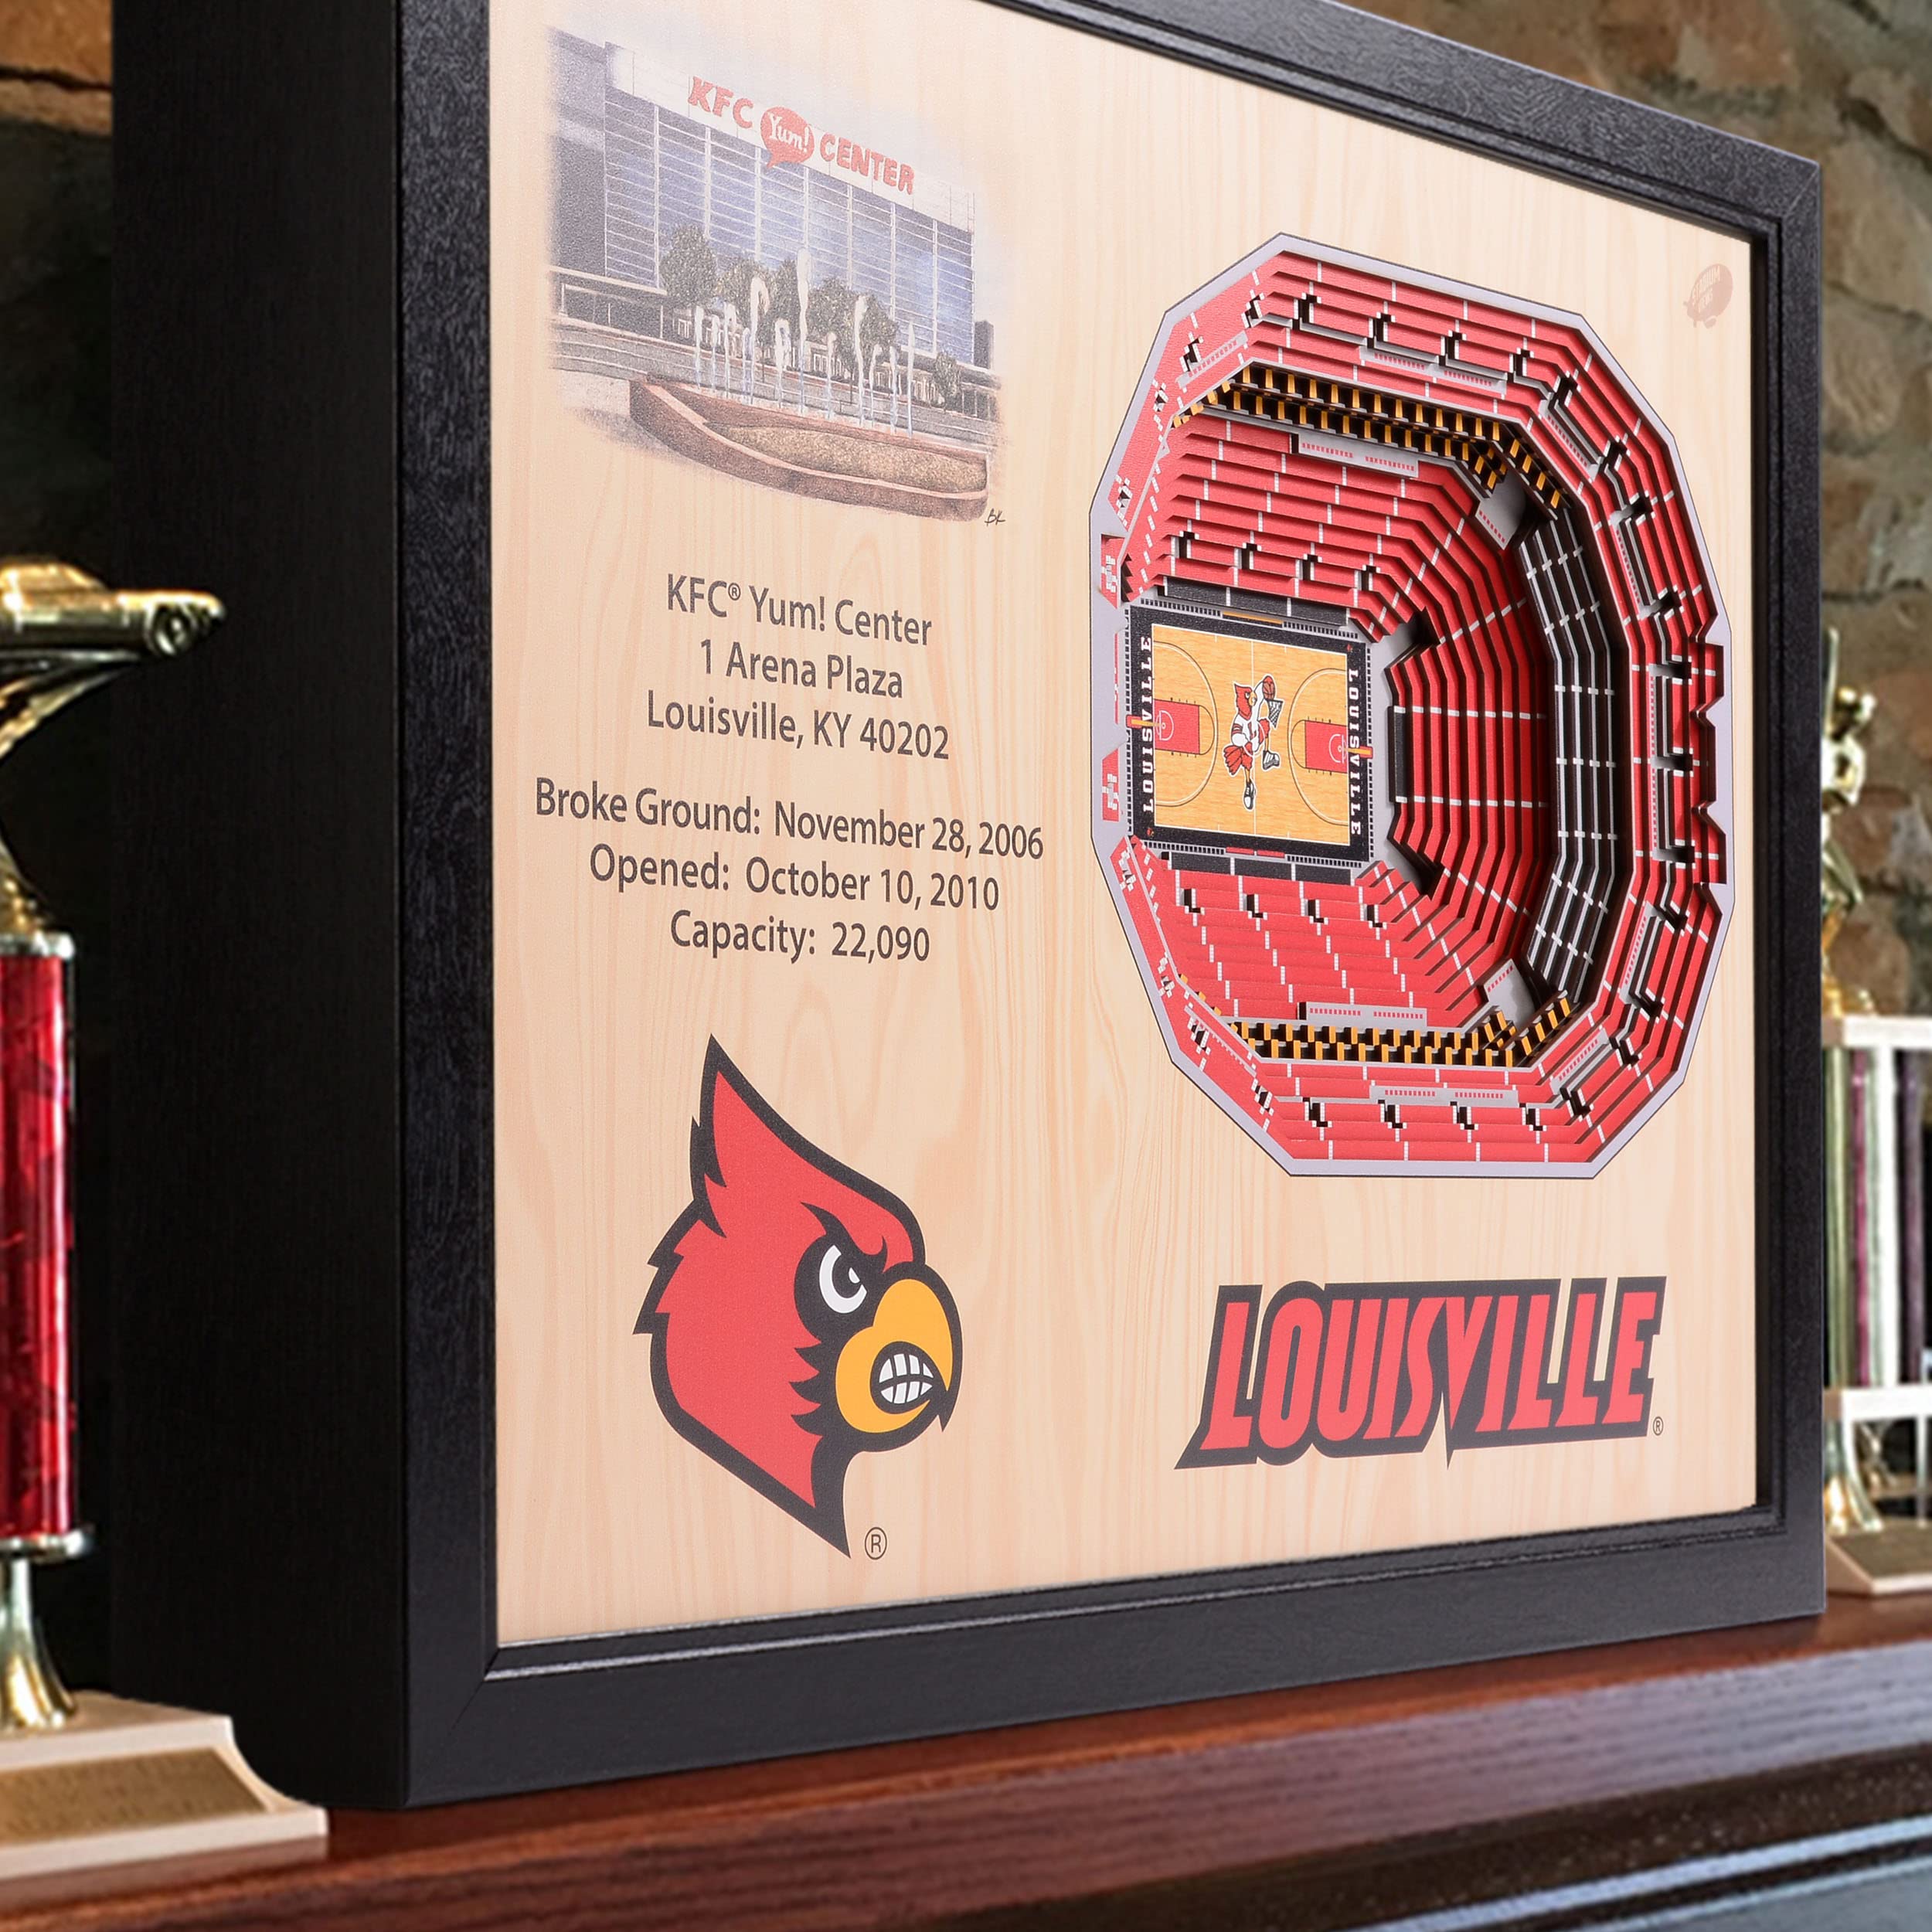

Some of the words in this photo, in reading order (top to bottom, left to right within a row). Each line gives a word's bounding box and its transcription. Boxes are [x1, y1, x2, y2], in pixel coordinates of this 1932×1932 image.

[688, 76, 754, 129] KFC
[768, 111, 810, 153] Yum!
[820, 131, 915, 196] CENTER
[749, 585, 825, 632] Yum!
[835, 599, 932, 646] Center
[701, 639, 711, 675] 1
[726, 641, 816, 688] Arena
[827, 654, 903, 699] Plaza
[648, 689, 804, 750] Louisville,
[814, 709, 852, 748] KY
[859, 717, 949, 760] 40202
[1141, 637, 1154, 813] LOUISVILLE
[1348, 668, 1361, 836] LOUISVILLE
[536, 777, 628, 823] Broke
[635, 787, 760, 835] Ground:
[775, 800, 925, 849] November
[931, 817, 971, 859] 28,
[978, 821, 1044, 860] 2006
[590, 843, 729, 893] Opened:
[746, 856, 870, 901] October
[880, 869, 922, 910] 10,
[930, 872, 999, 911] 2010
[670, 909, 815, 964] Capacity:
[832, 921, 930, 964] 22,090
[1173, 1275, 1667, 1471] LOUISVILLE
